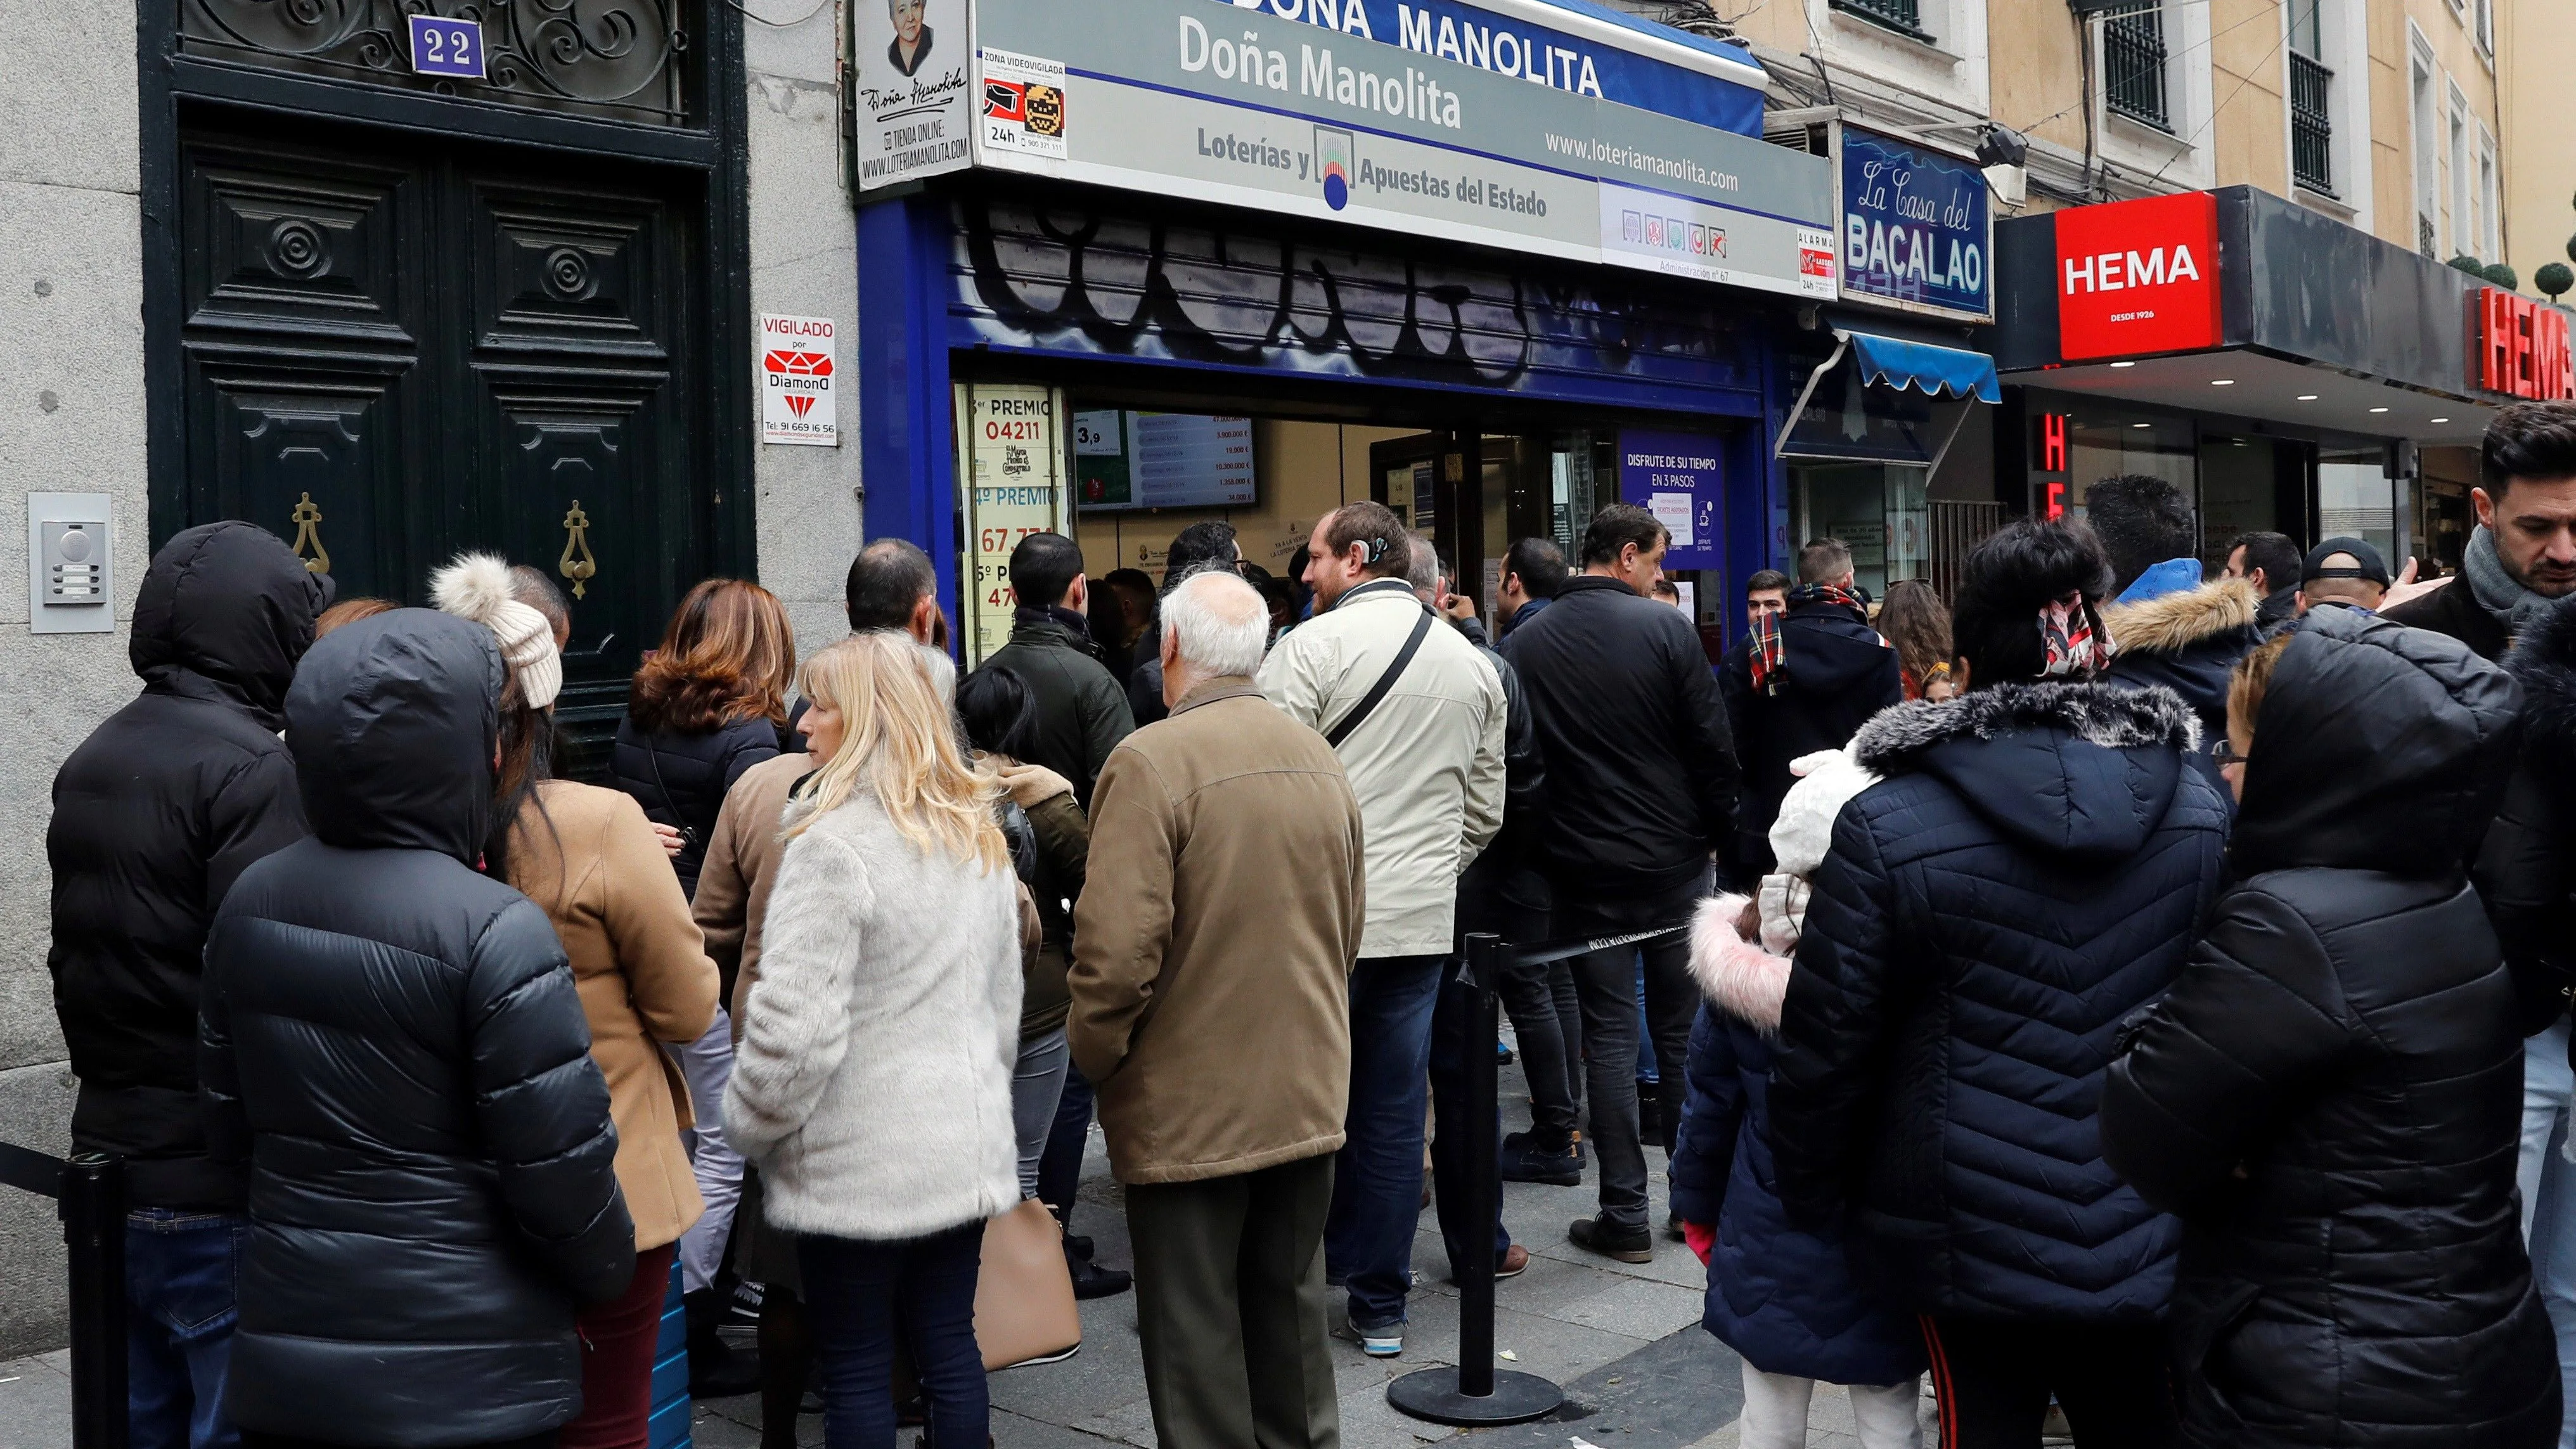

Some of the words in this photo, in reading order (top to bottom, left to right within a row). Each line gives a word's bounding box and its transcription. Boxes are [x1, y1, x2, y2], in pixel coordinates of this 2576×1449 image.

[424, 29, 471, 66] 22
[1398, 3, 1604, 99] MANOLITA
[984, 52, 1005, 64] ZONA
[1007, 57, 1064, 75] VIDEOVIGILADA
[1178, 15, 1289, 92] Doña
[1301, 44, 1462, 129] Manolita
[893, 125, 917, 148] TIENDA
[918, 119, 944, 142] ONLINE:
[991, 127, 1015, 143] 24h
[863, 138, 967, 179] WWW.LOTERIAMANOLITA.COM
[1197, 127, 1291, 169] Loterías
[1298, 151, 1310, 181] y
[1545, 132, 1739, 193] www.loteriamanolita.com
[1359, 158, 1451, 200] Apuestas
[1455, 174, 1484, 206] del
[1488, 182, 1547, 217] Estado
[1859, 162, 1887, 211] La
[1891, 166, 1937, 224] Casa
[1944, 188, 1972, 232] del
[1799, 233, 1833, 248] ALARMA
[1847, 213, 1982, 295] BACALAO
[1660, 261, 1710, 280] Administración
[1720, 271, 1729, 281] 67
[2065, 244, 2200, 295] HEMA
[1803, 280, 1813, 290] 24h
[2110, 312, 2135, 322] DESDE
[2136, 310, 2154, 320] 1926
[763, 317, 834, 338] VIGILADO
[792, 341, 806, 349] por
[2480, 286, 2576, 401] HEMA
[991, 399, 1050, 416] PREMIO
[780, 422, 789, 430] 91
[792, 423, 809, 431] 669
[812, 424, 820, 432] 16
[823, 425, 834, 433] 56
[986, 421, 1040, 440] 04211
[1628, 453, 1665, 468] DISFRUTE
[1666, 456, 1676, 468] DE
[1677, 457, 1687, 469] SU
[1689, 458, 1716, 470] TIEMPO
[1652, 474, 1663, 486] EN
[1664, 475, 1669, 487] 3
[1670, 475, 1695, 488] PASOS
[997, 488, 1059, 506] PREMIO
